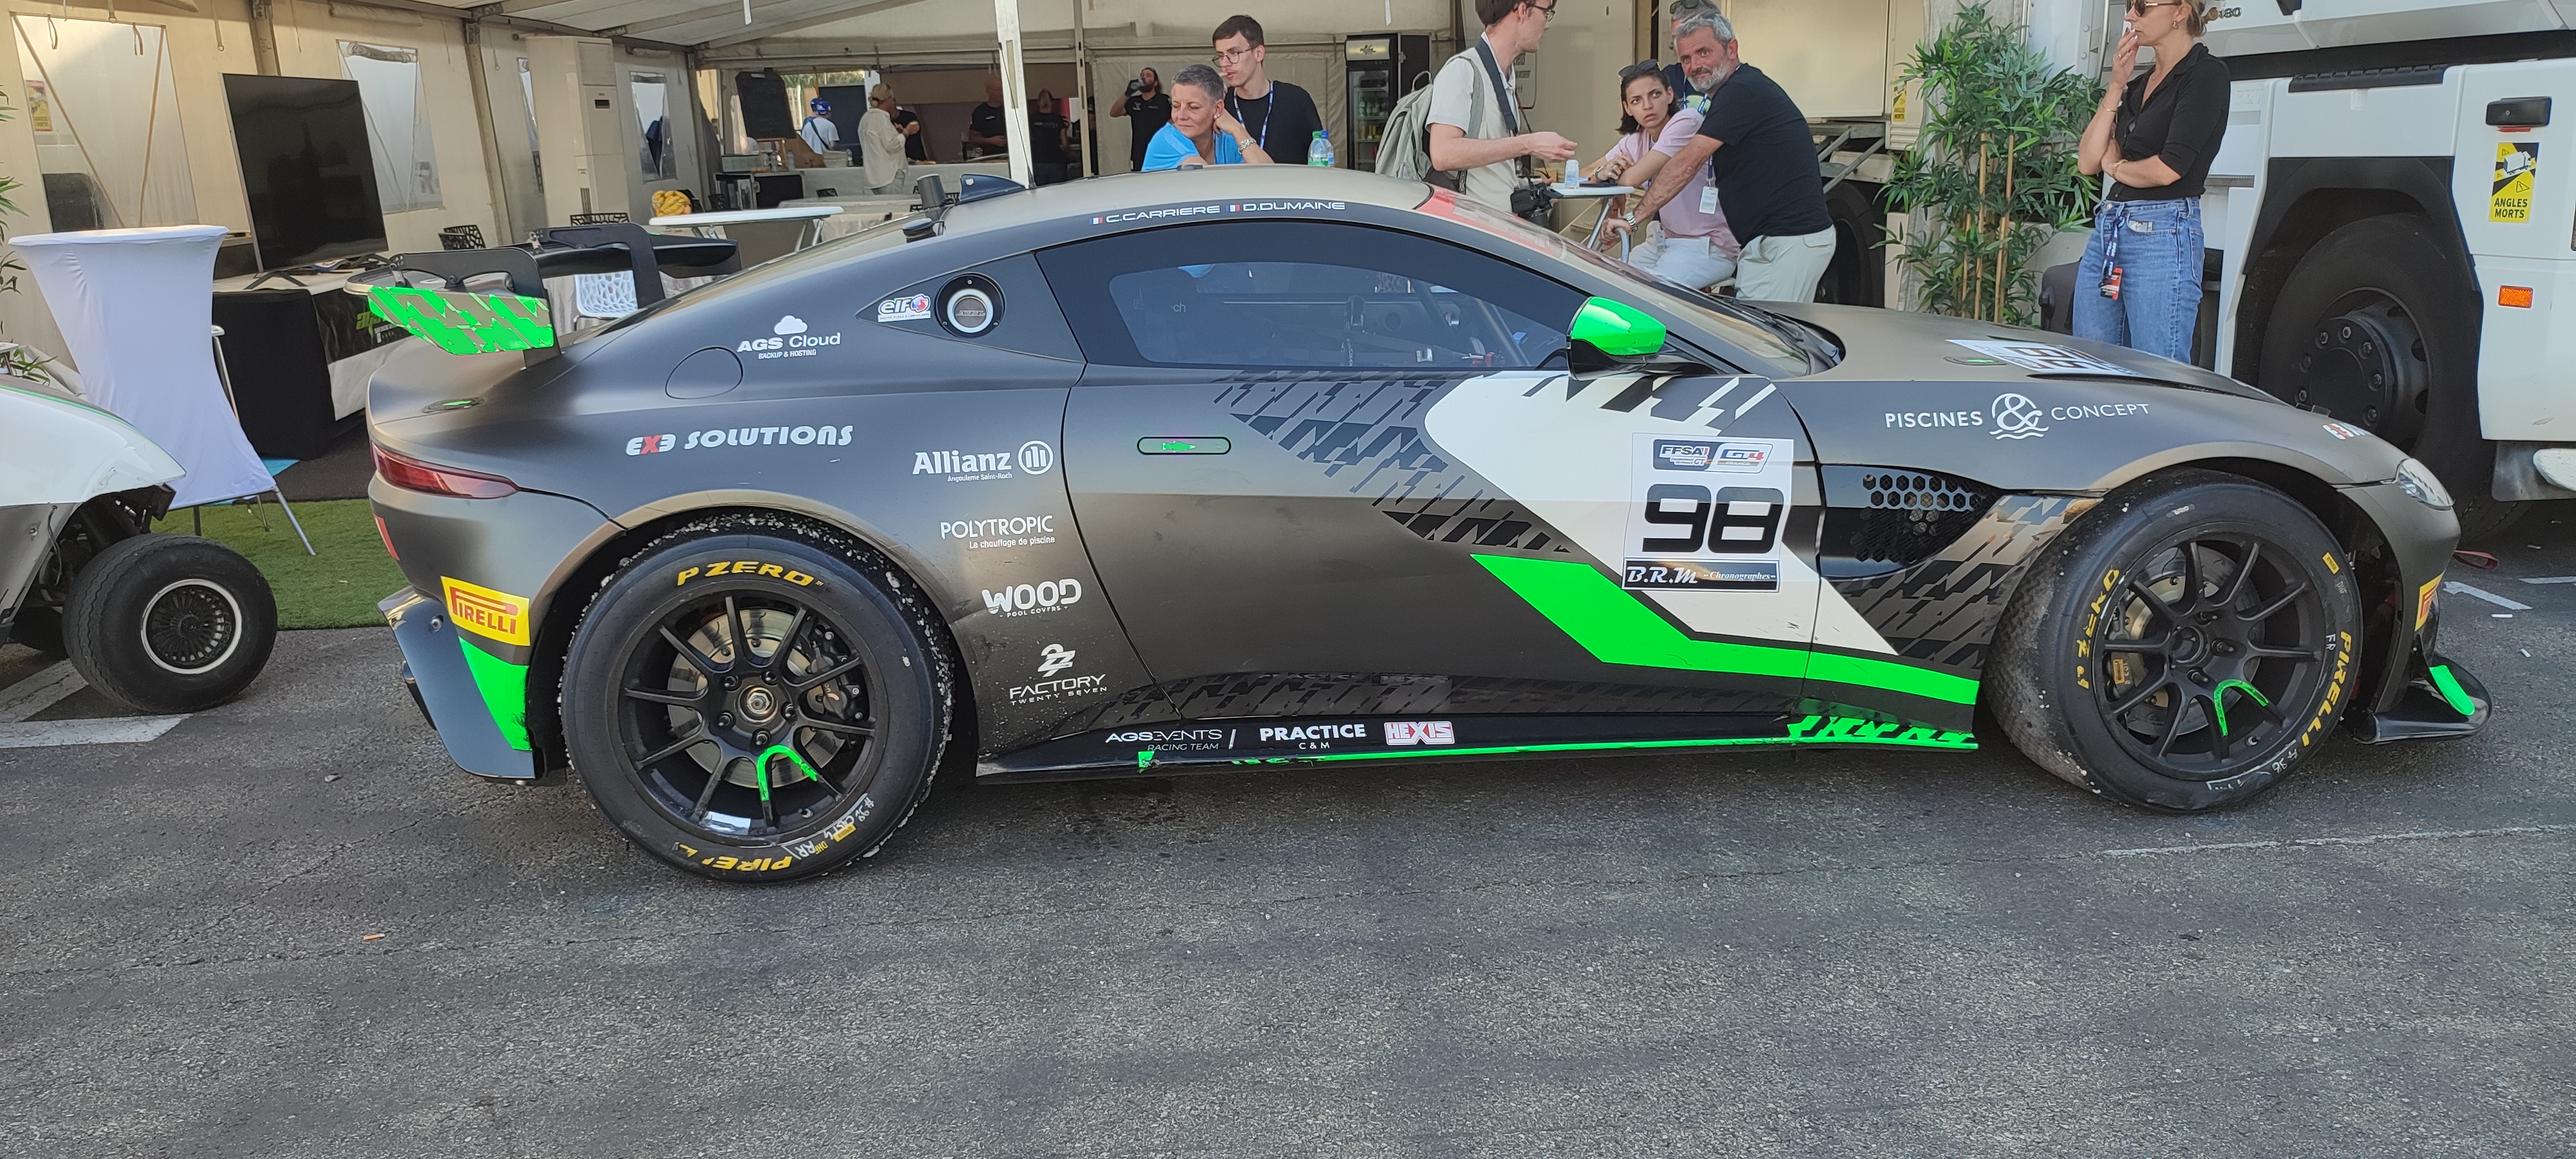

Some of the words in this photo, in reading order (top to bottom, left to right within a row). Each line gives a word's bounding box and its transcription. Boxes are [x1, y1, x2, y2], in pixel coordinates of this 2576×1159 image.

[1106, 205, 1221, 223] C.CARRIERE
[1243, 202, 1346, 212] D.DUMAINE
[2494, 198, 2528, 208] ANGLES
[2494, 209, 2525, 218] MORTS
[880, 298, 912, 314] elf
[737, 337, 784, 352] AGS
[789, 332, 841, 348] Cloud
[790, 349, 817, 357] HOSTING
[1885, 411, 1983, 428] PISCINES
[2051, 403, 2150, 421] CONCEPT
[684, 425, 854, 449] SOLUTIONS
[912, 450, 1012, 475] Allianz
[981, 472, 1013, 480] Saint-Roch
[940, 515, 1054, 540] POLYTROPIC
[1642, 484, 1785, 554] 98
[980, 539, 1016, 549] chauffage
[1030, 535, 1056, 546] piscine
[677, 567, 699, 586] P
[705, 561, 815, 586] ZERO
[981, 578, 1082, 614] WOOD
[450, 586, 518, 635] PIRELLI
[1009, 674, 1106, 699] FACTORY
[1010, 693, 1060, 706] TWENTY
[1068, 686, 1107, 697] SEVEN
[2302, 631, 2352, 746] PIRELLI
[1260, 724, 1367, 741] PRACTICE
[1385, 722, 1453, 744] HEXIS
